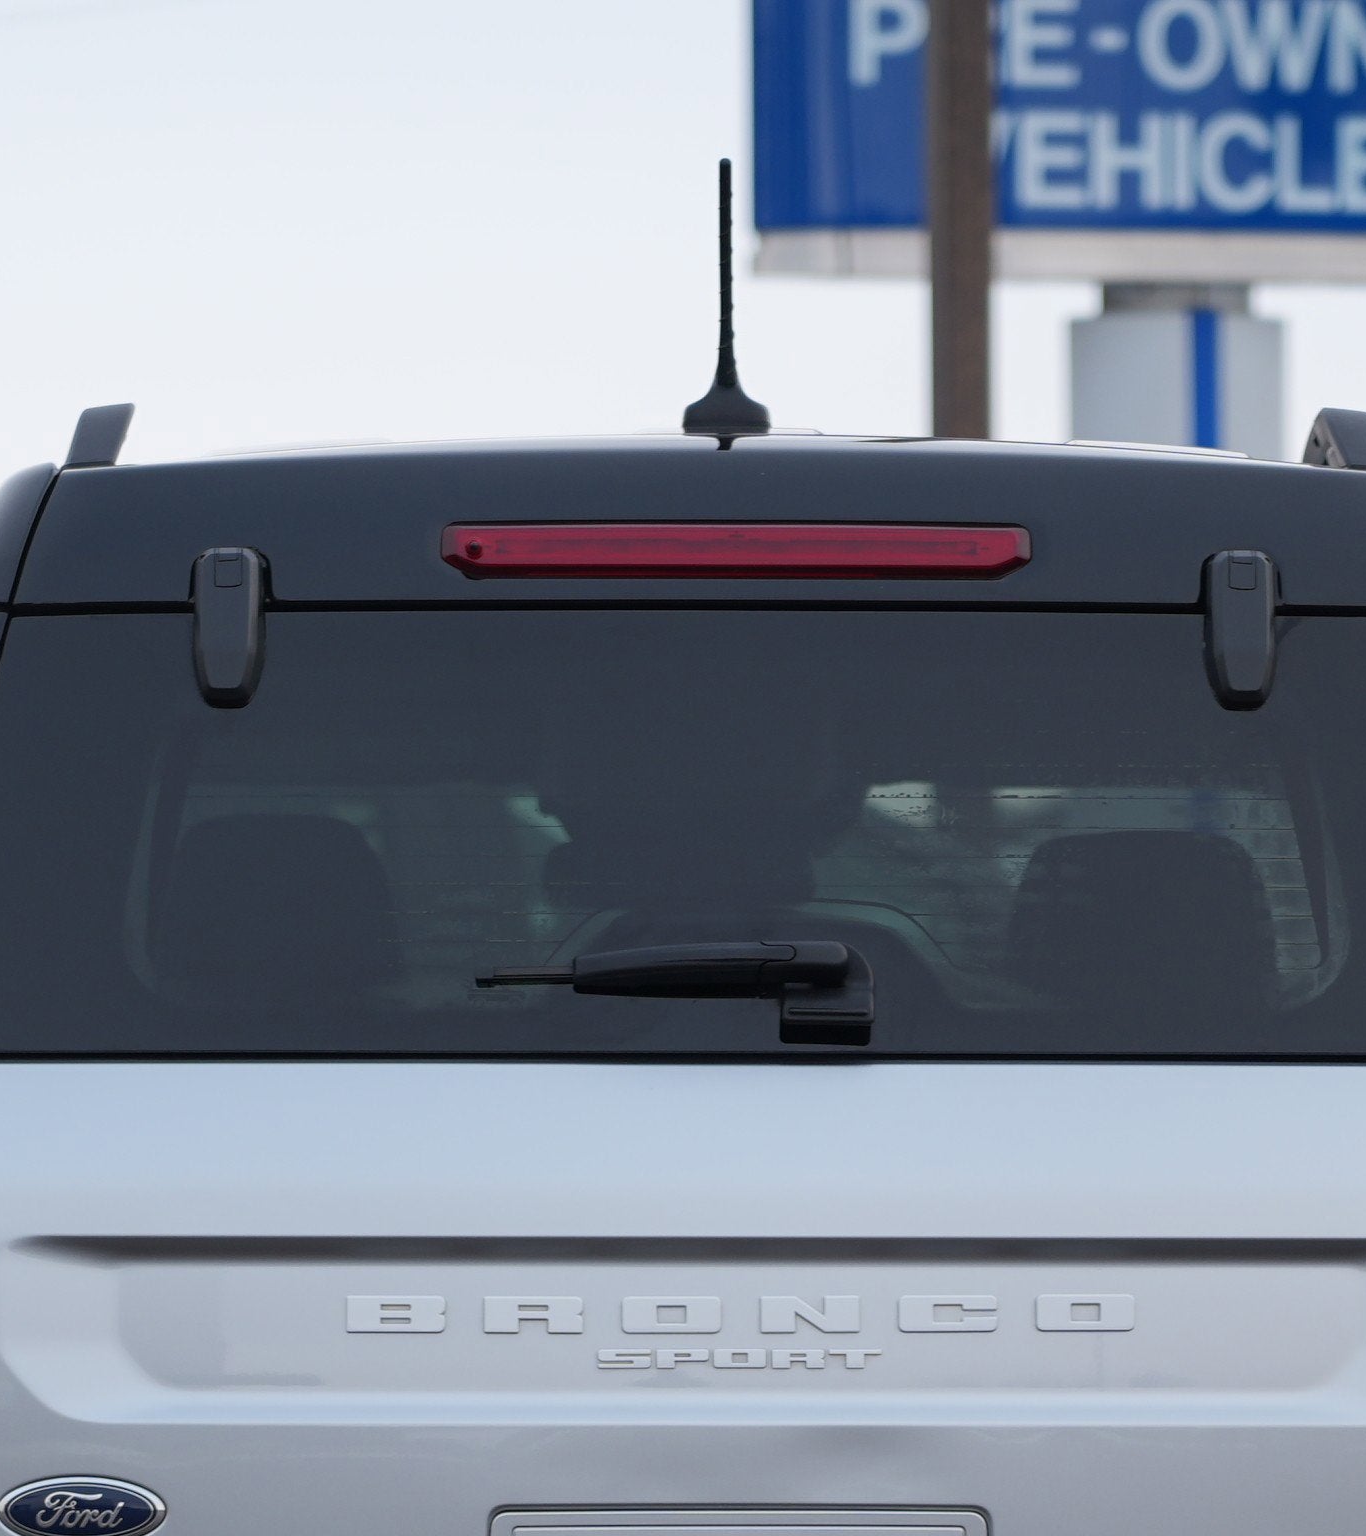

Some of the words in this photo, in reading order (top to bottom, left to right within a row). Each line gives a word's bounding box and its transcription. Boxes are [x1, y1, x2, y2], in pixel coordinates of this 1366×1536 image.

[346, 1294, 1135, 1334] BRONCO
[596, 1348, 882, 1370] SPORT
[36, 1491, 125, 1529] Ford
